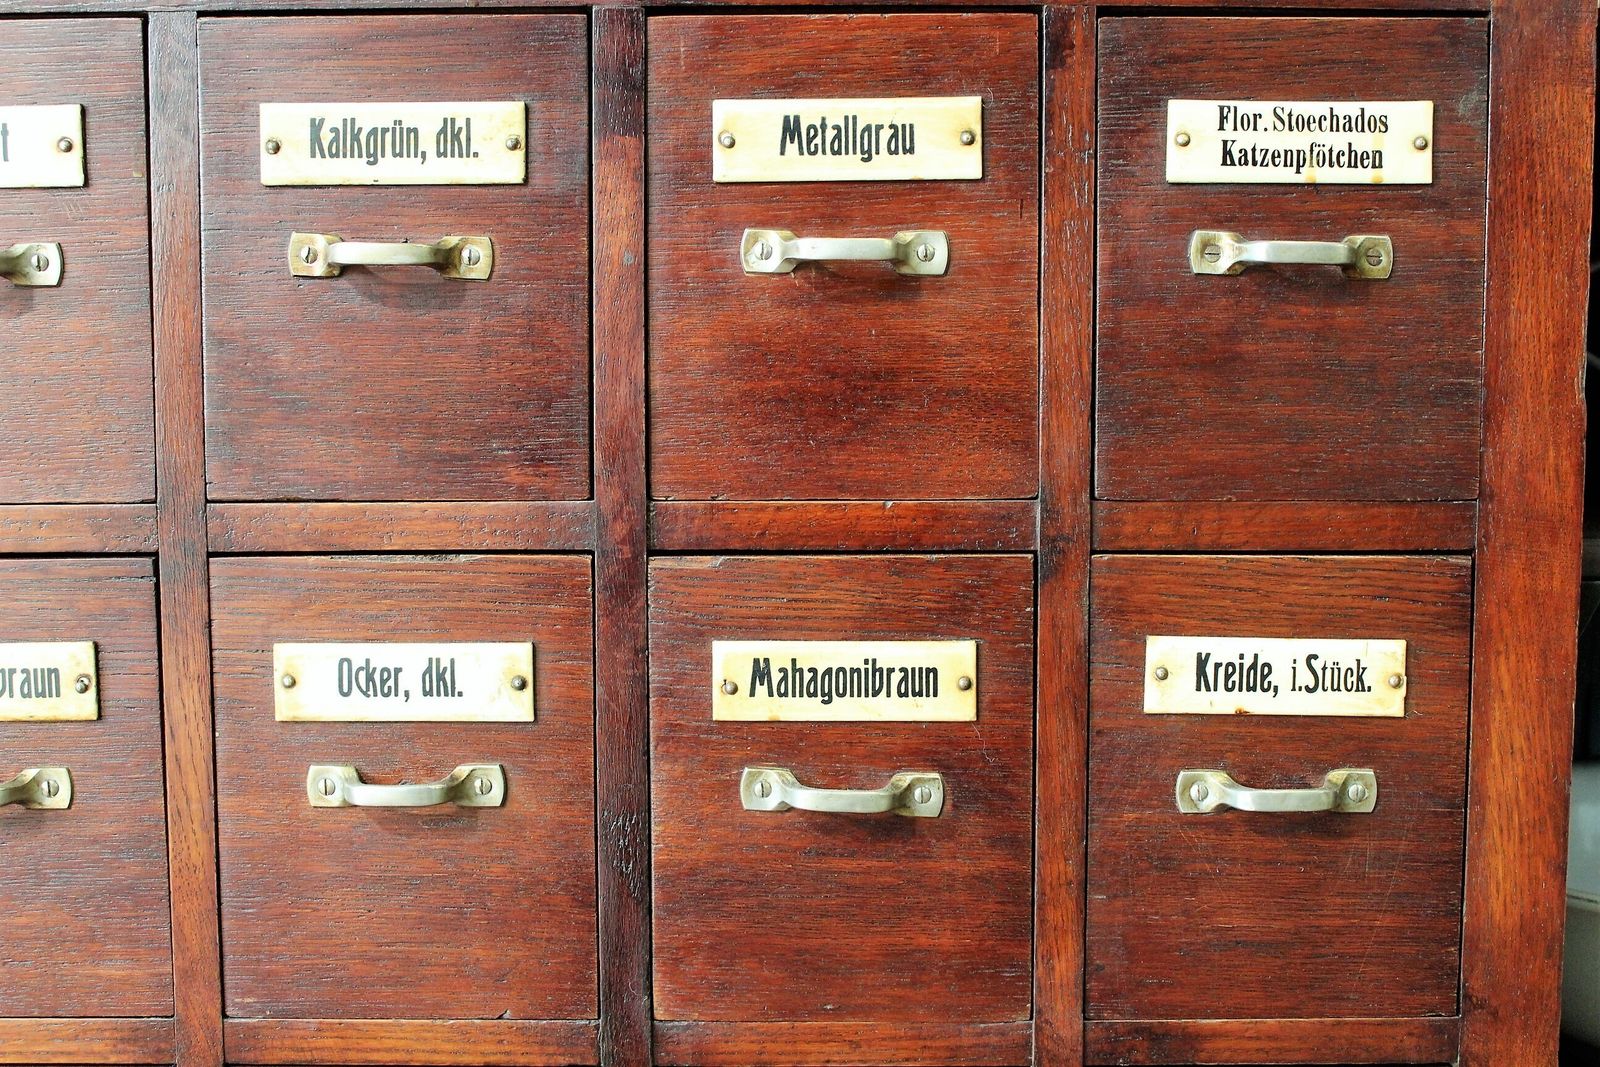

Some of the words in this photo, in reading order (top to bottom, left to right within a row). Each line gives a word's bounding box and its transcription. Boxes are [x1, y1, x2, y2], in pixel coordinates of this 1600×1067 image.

[309, 116, 427, 166] Kalkgrün,
[435, 116, 480, 159] dkl.
[779, 114, 916, 163] Metallgrau
[1217, 104, 1268, 133] Flor.
[1272, 105, 1389, 134] Stoechados
[1220, 139, 1384, 175] Katzenpfötchen
[337, 656, 410, 703] Ocker,
[421, 656, 464, 699] dkl.
[748, 657, 939, 705] Mahagonibraun
[1195, 652, 1279, 698] Kreide,
